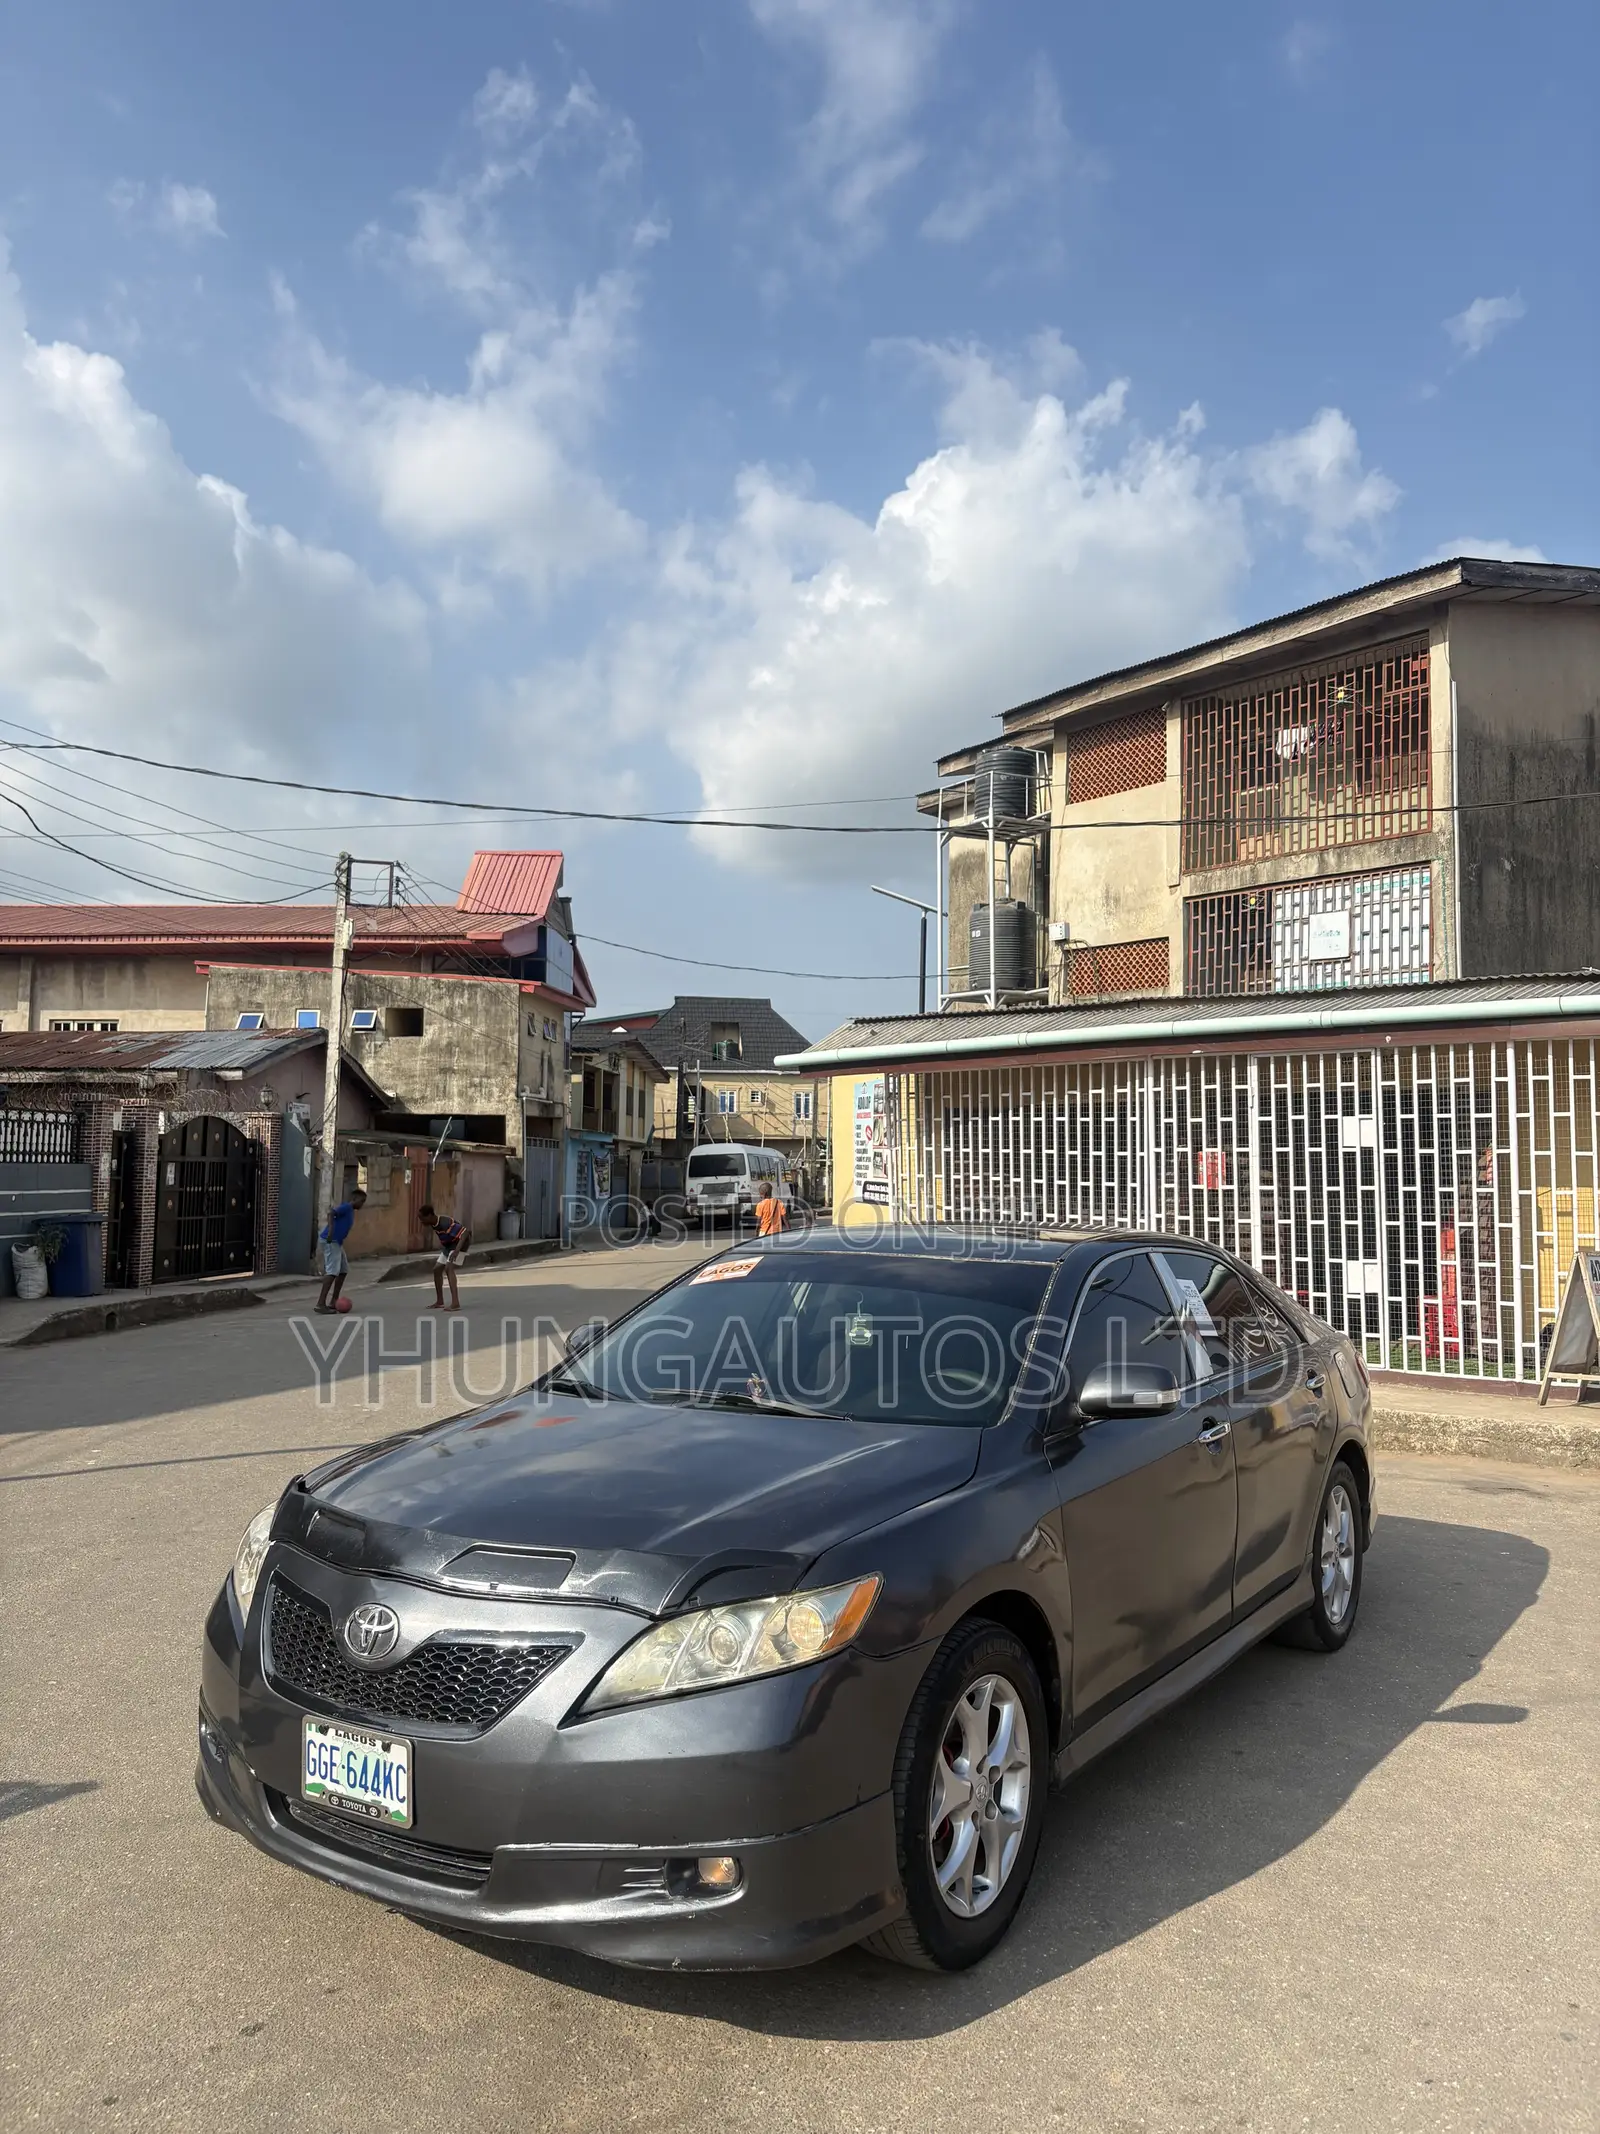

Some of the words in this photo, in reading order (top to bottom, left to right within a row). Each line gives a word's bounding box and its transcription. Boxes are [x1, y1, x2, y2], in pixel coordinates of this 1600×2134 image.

[700, 1263, 753, 1278] LAGOS
[334, 1729, 377, 1747] LAGOS
[342, 1799, 367, 1813] TOYOTA
